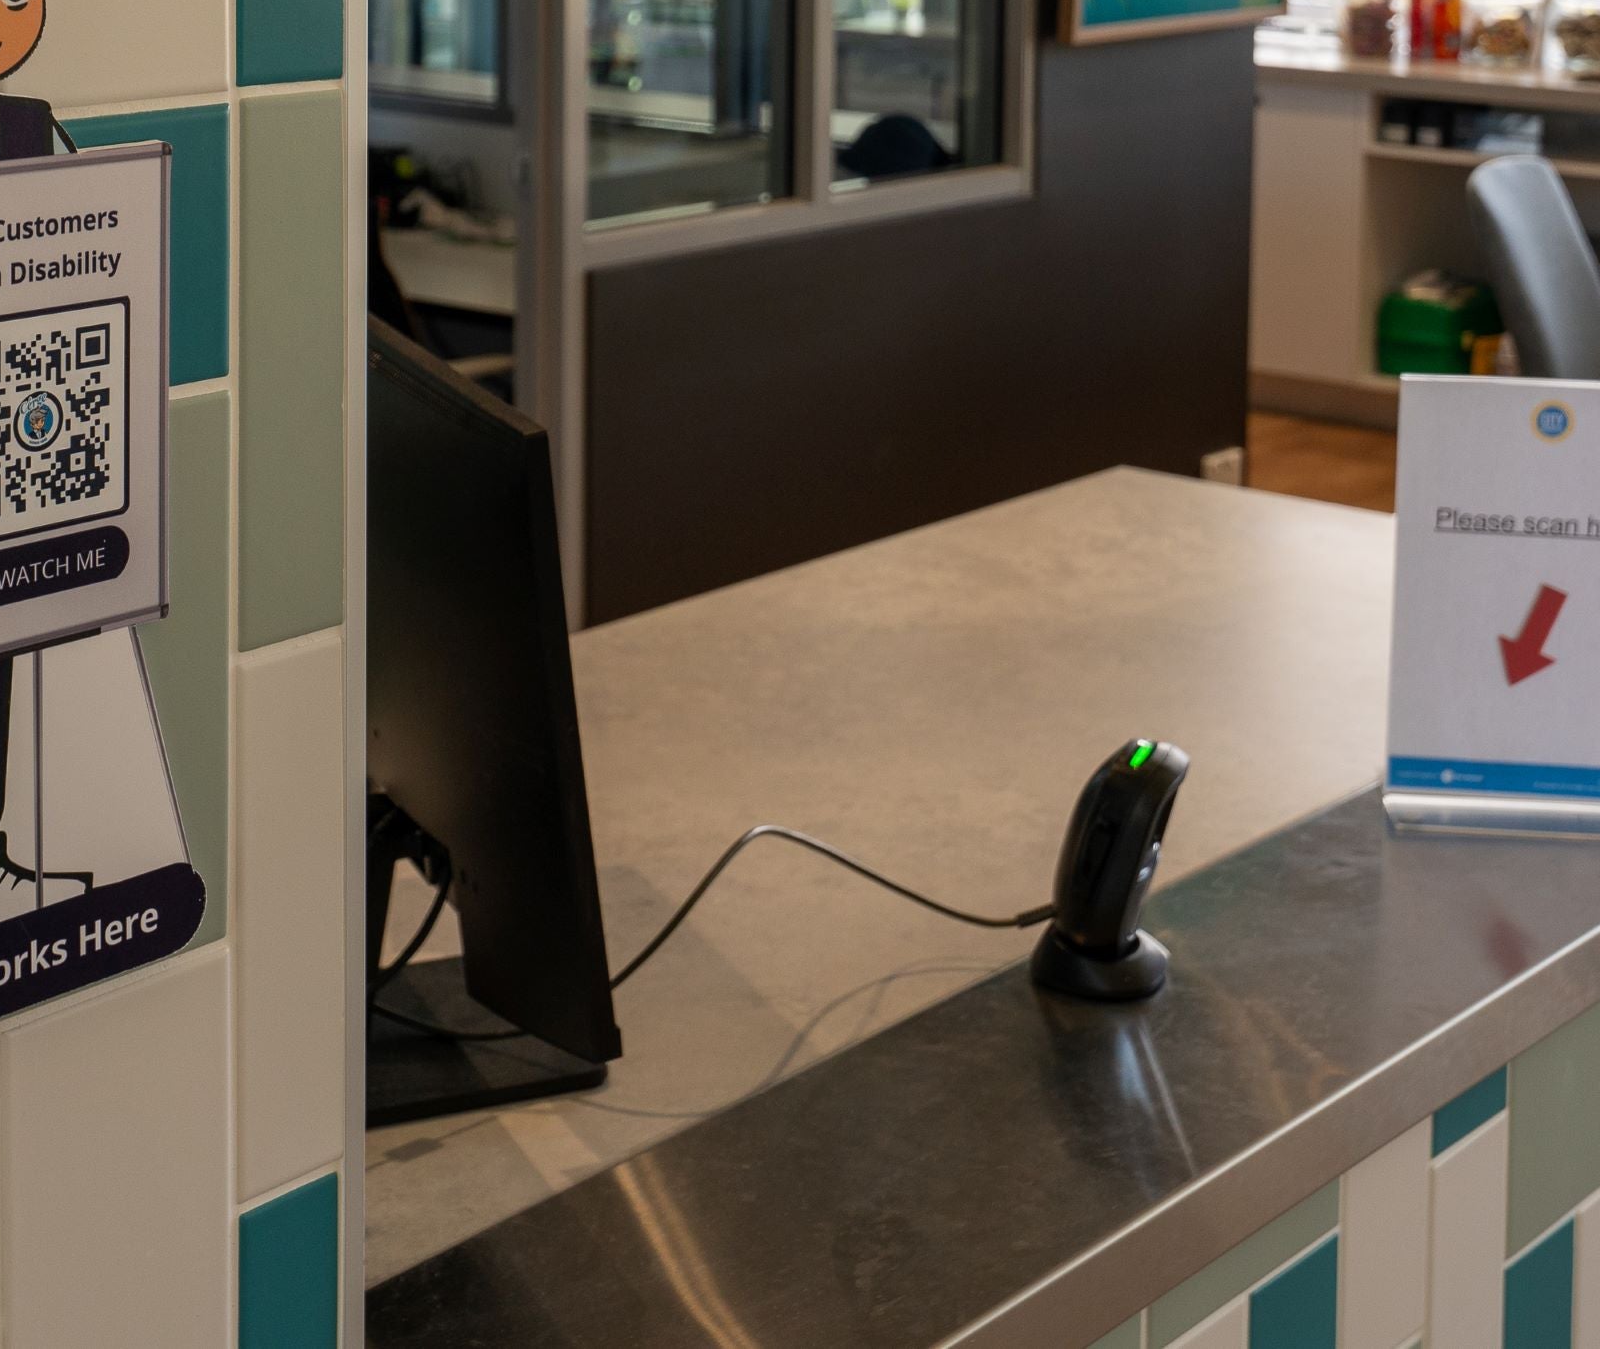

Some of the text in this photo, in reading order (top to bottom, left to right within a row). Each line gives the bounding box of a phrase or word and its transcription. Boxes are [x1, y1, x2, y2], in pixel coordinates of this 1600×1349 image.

[10, 248, 123, 287] Disability
[1435, 506, 1516, 534] Please
[1523, 515, 1578, 538] scan
[76, 546, 107, 572] ME
[79, 907, 159, 957] Here
